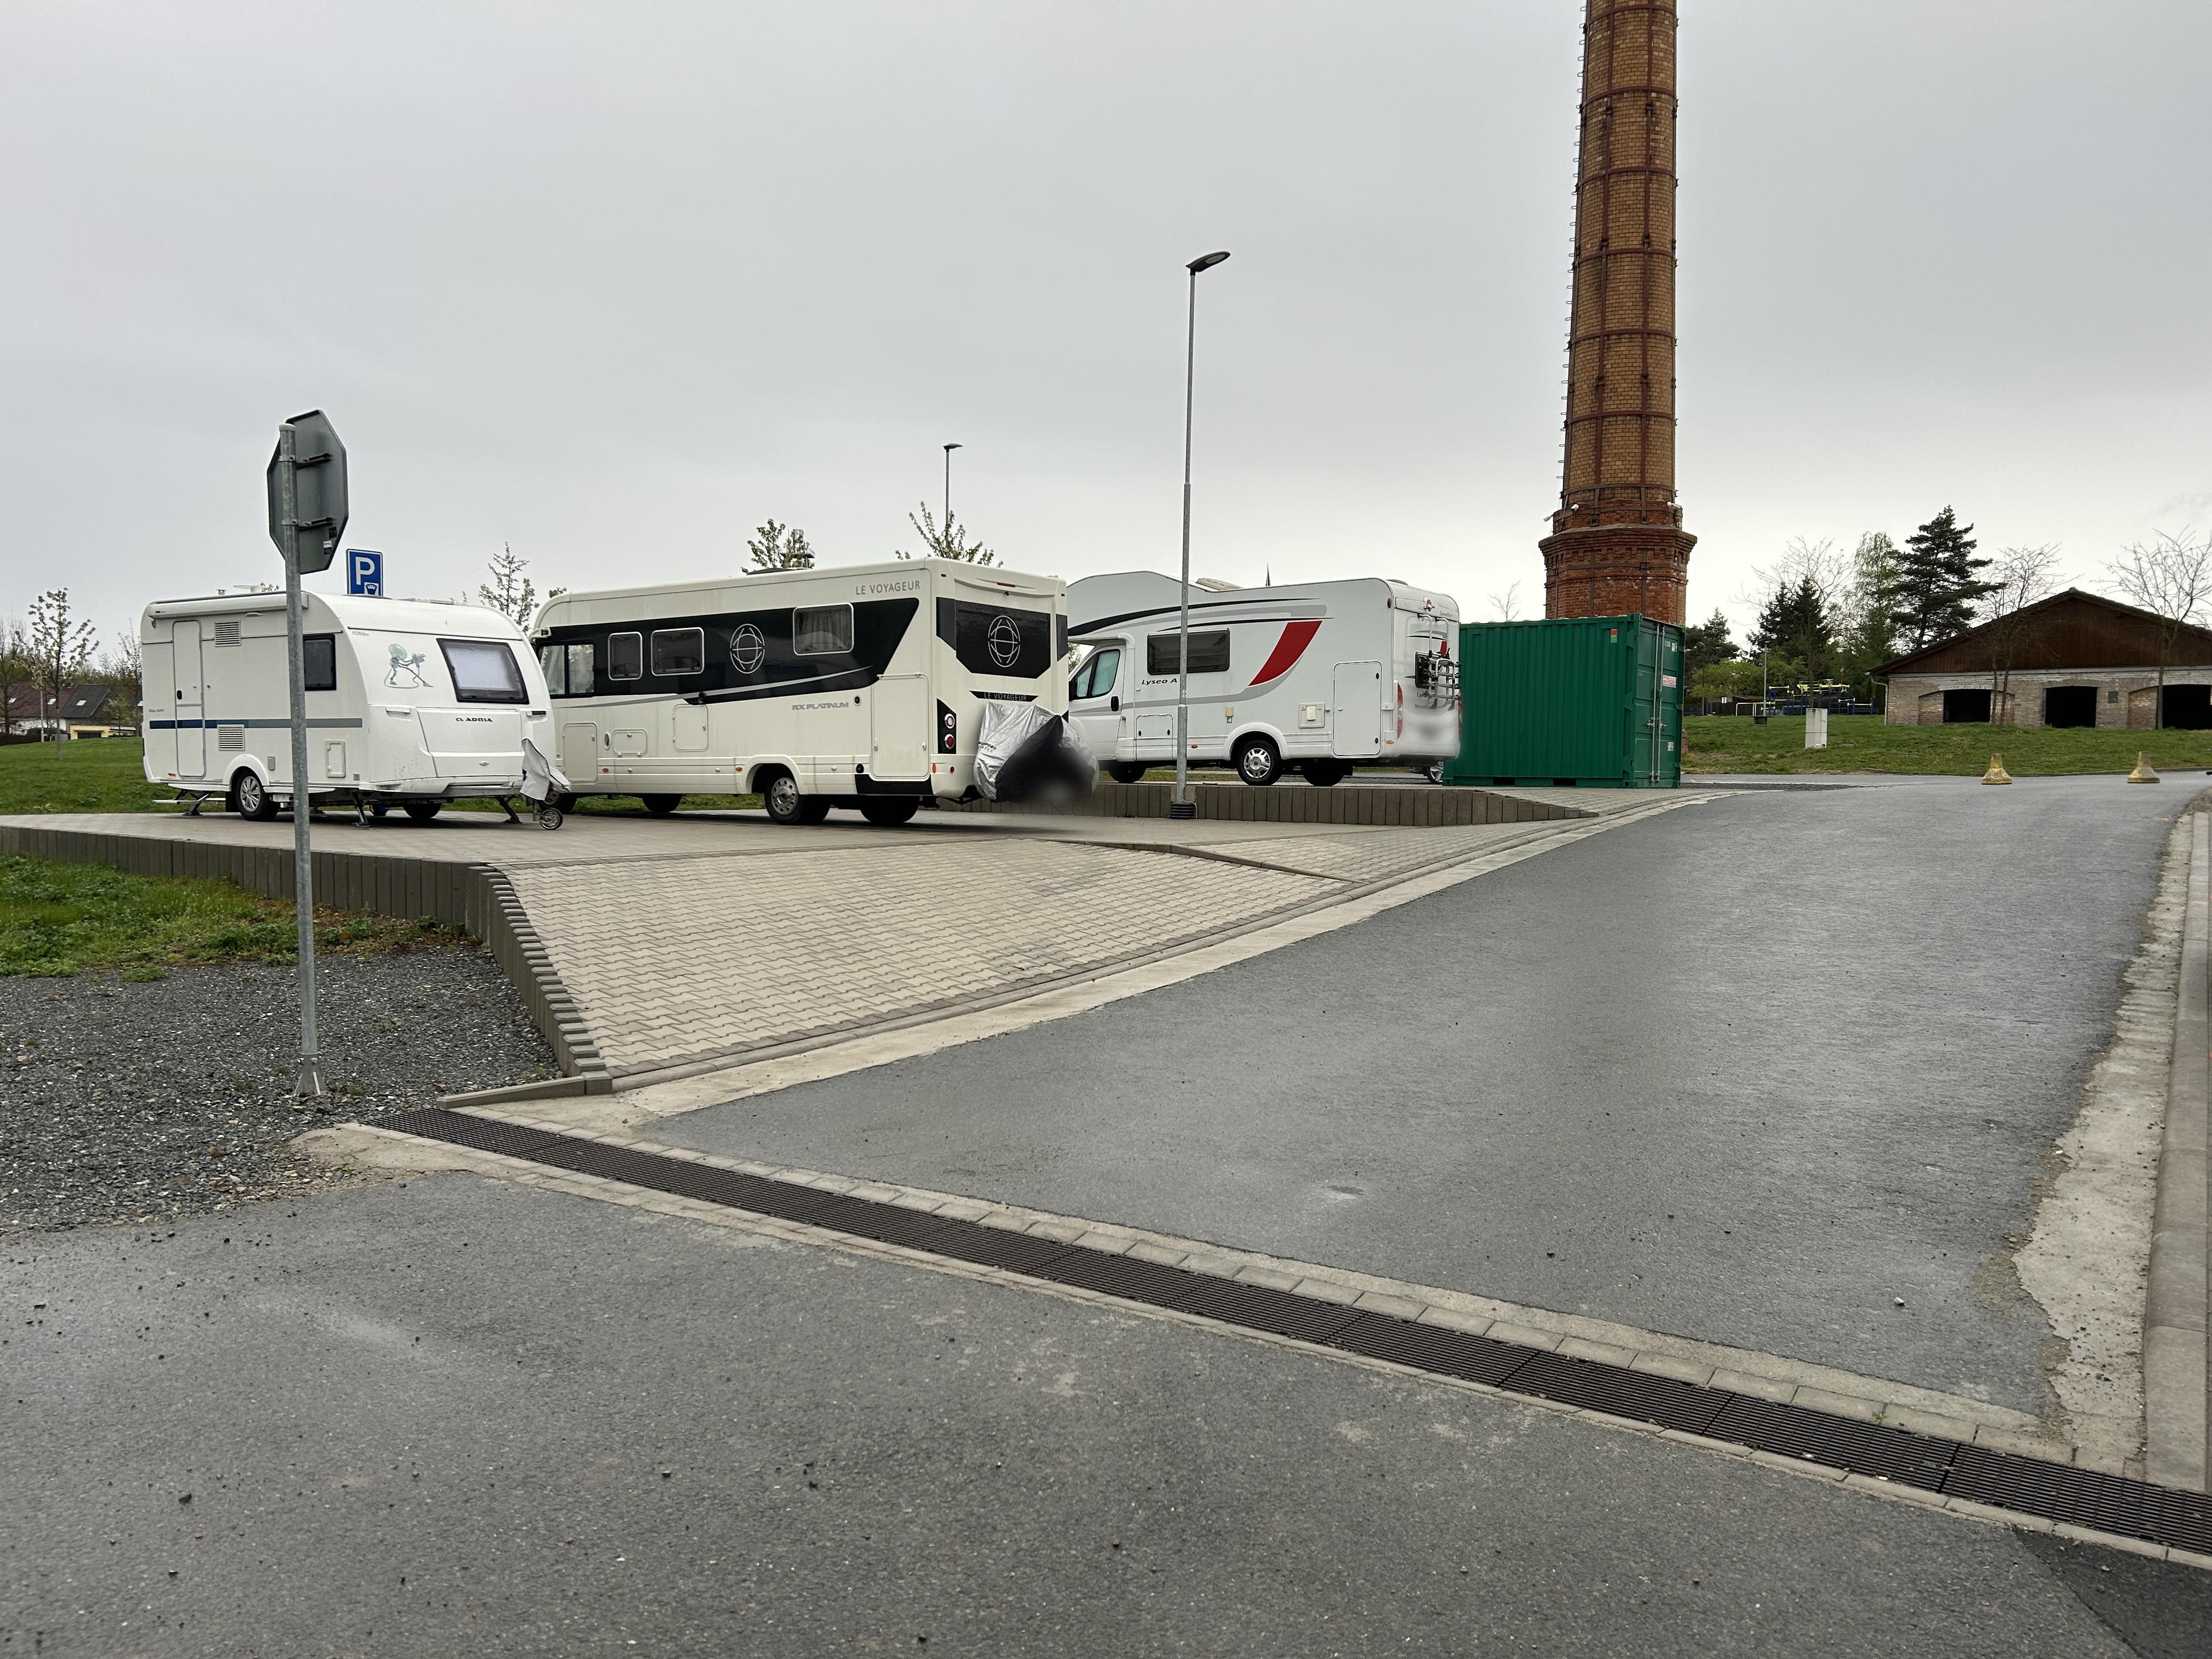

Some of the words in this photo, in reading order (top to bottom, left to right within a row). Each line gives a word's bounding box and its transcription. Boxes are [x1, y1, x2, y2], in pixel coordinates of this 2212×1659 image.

[356, 556, 375, 585] P
[855, 585, 866, 595] LE
[869, 580, 921, 594] VOYAGEUR
[993, 692, 1027, 702] VOYAGEUR
